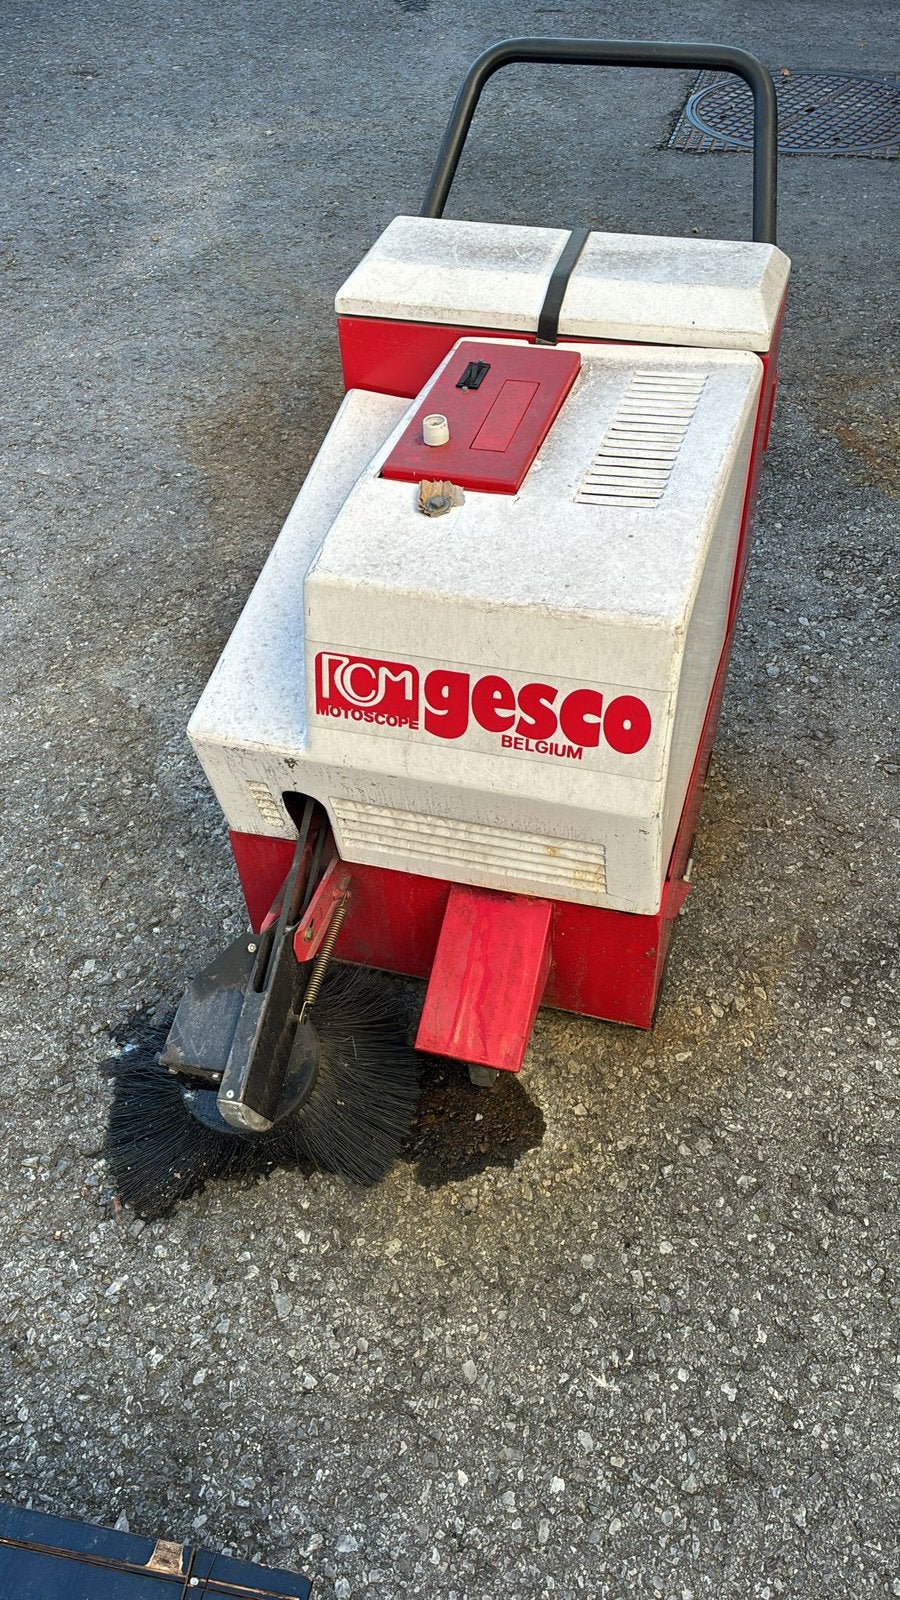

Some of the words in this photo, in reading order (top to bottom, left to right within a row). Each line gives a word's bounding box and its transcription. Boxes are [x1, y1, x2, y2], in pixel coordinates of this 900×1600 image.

[320, 652, 414, 708] RCM
[315, 704, 420, 730] MOTOSCOPE
[424, 669, 652, 754] gesco
[501, 734, 583, 760] BELGIUM
